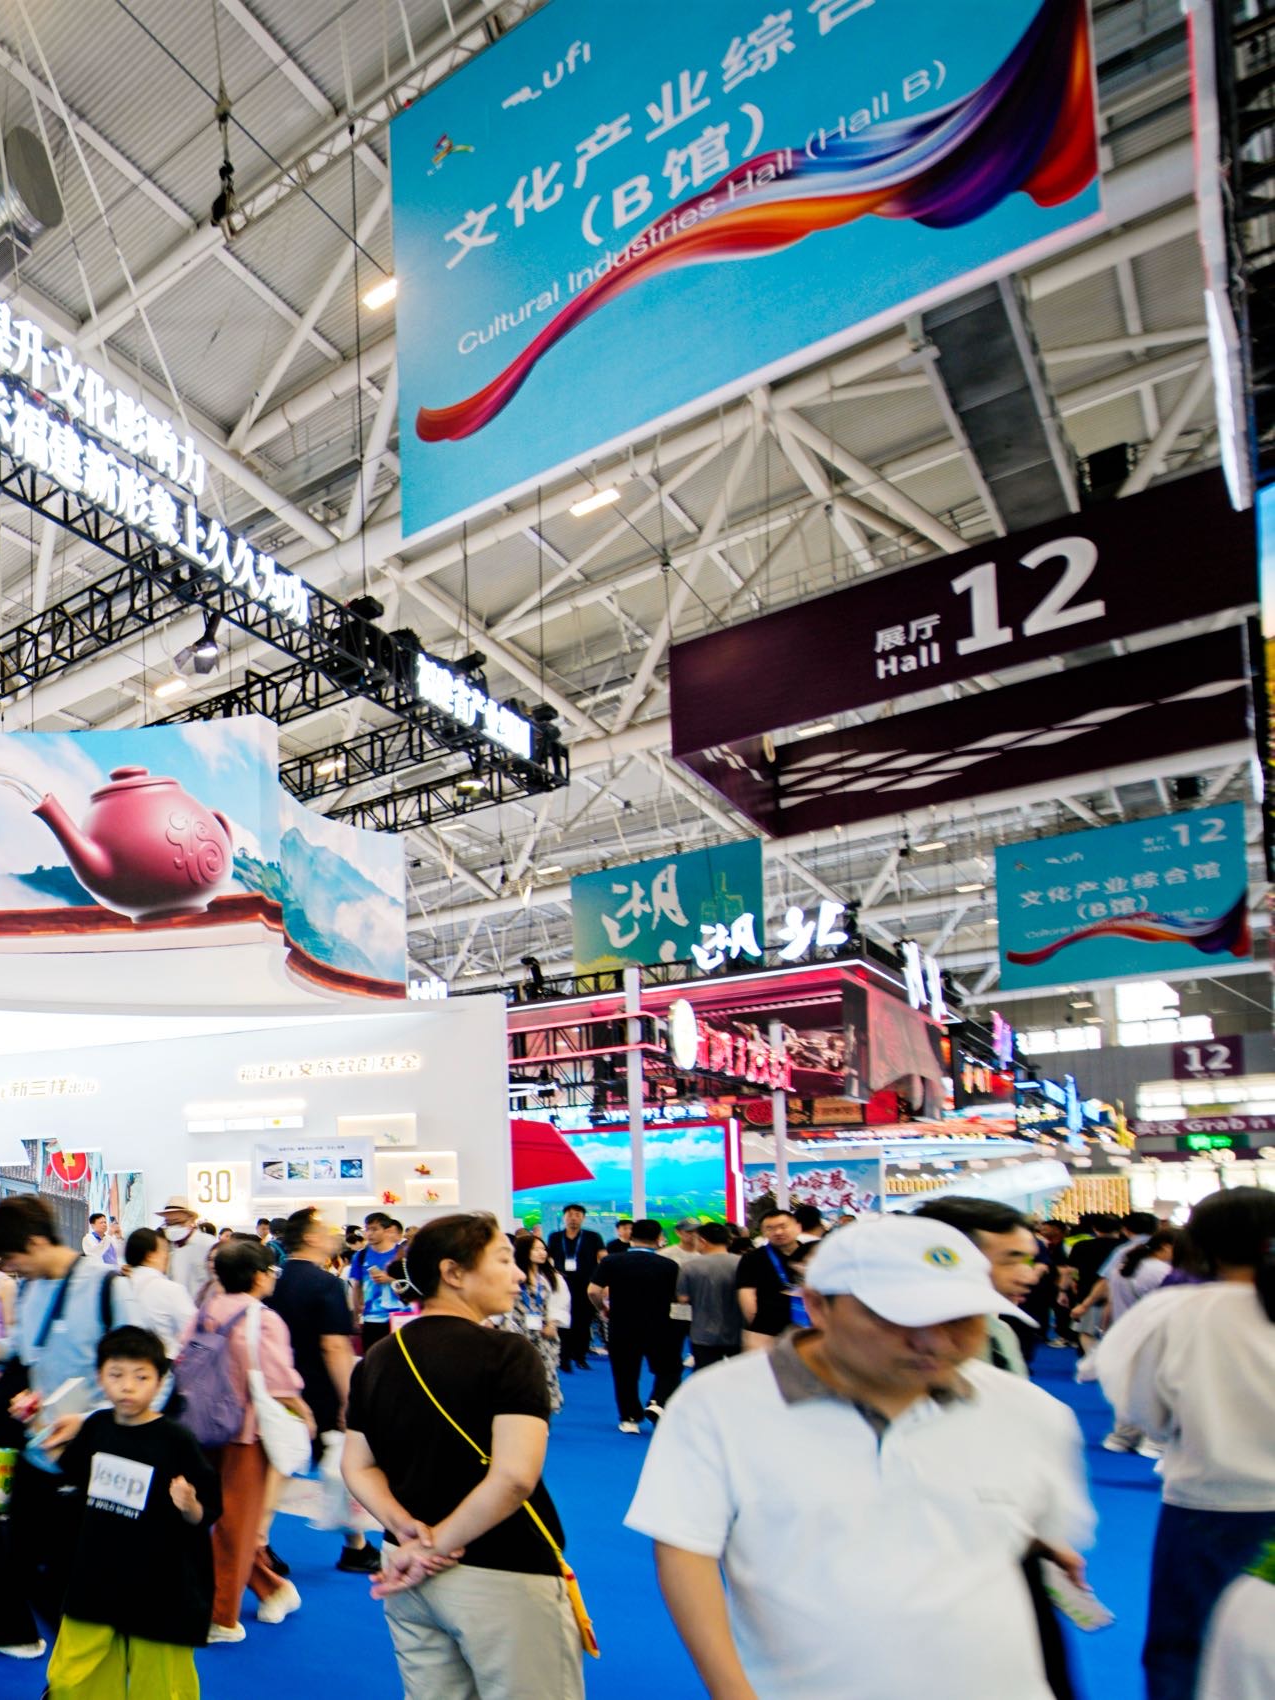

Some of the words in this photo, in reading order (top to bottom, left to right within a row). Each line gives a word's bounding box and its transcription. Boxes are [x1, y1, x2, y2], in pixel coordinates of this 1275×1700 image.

[457, 281, 560, 356] Cultural
[567, 195, 718, 295] Industries
[726, 147, 794, 203] Hall
[805, 91, 890, 162] (Hall
[900, 58, 947, 105] B)
[875, 642, 941, 680] Hall
[949, 534, 1107, 657] 12
[875, 612, 942, 655] 展厅
[1170, 817, 1227, 848] 12
[1021, 860, 1222, 908] 文化产业综合馆
[1183, 1043, 1233, 1072] 12
[197, 1170, 232, 1204] 30
